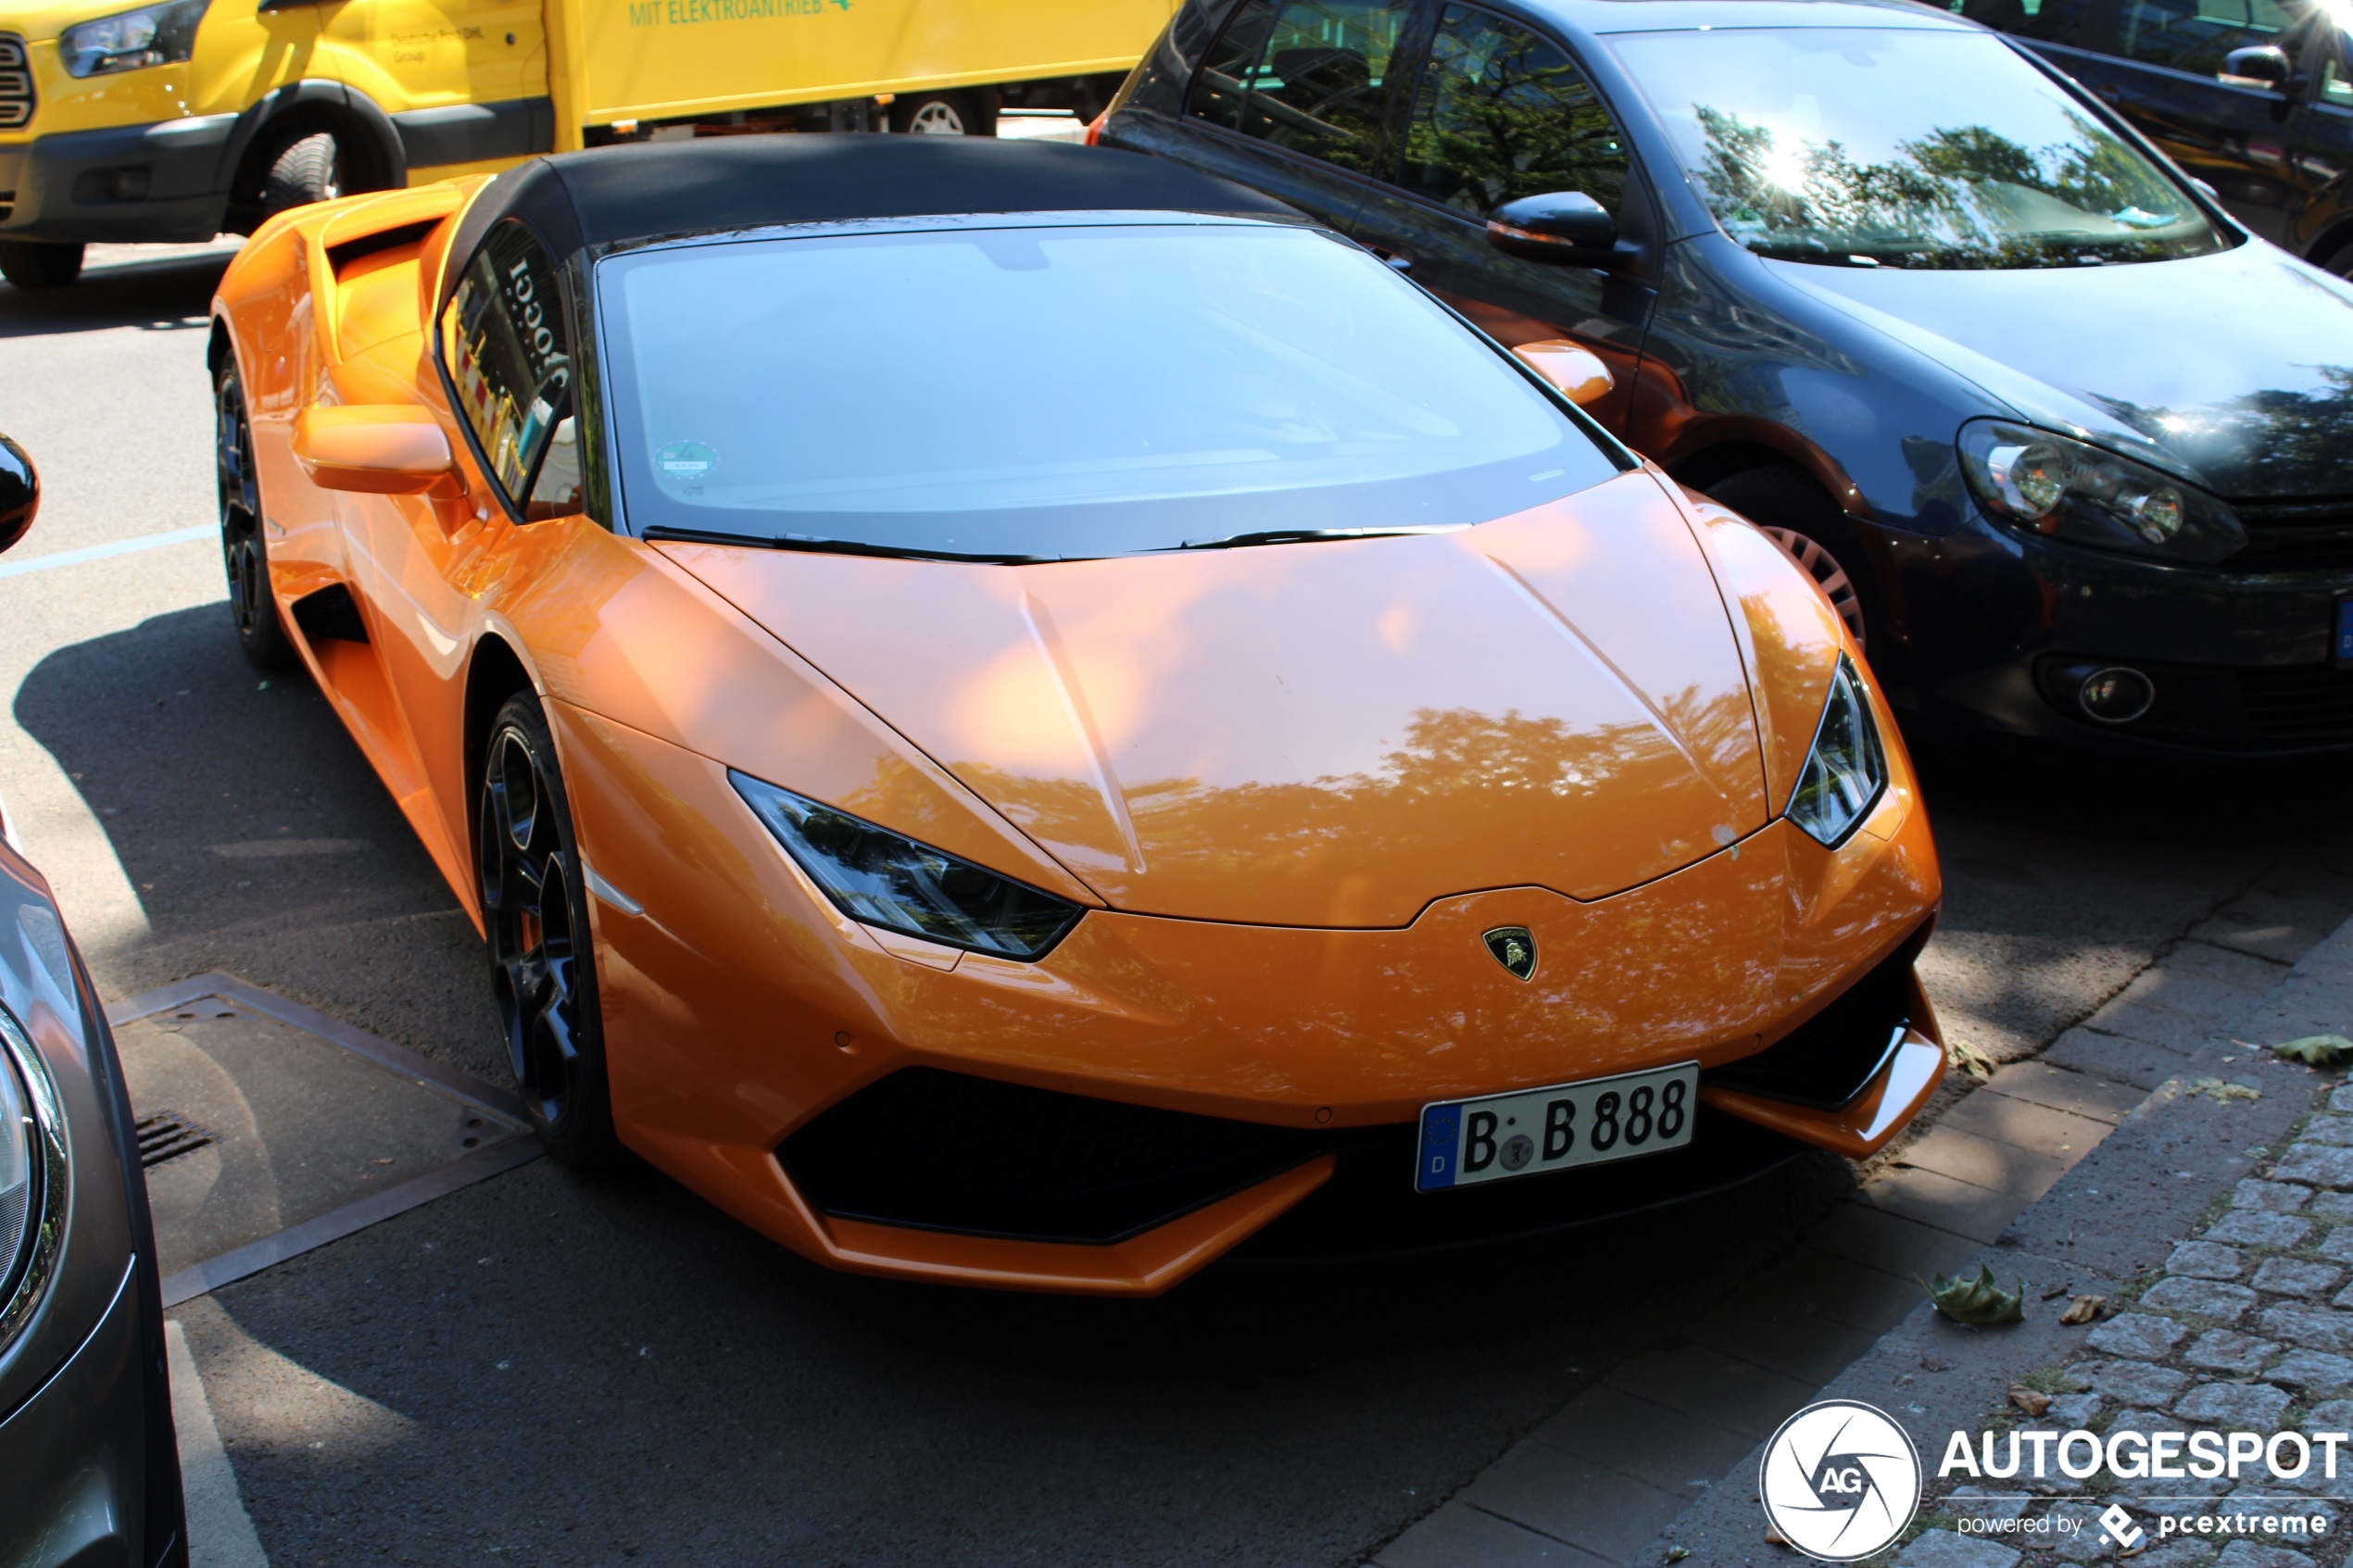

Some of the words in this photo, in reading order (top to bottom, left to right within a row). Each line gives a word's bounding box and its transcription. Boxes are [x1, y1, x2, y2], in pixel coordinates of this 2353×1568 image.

[629, 2, 661, 27] MIT
[391, 31, 437, 46] Deutsche
[439, 29, 462, 44] Post
[463, 27, 484, 40] DHL
[394, 49, 425, 64] Group
[678, 444, 695, 459] 4
[1464, 1110, 1498, 1173] B
[1432, 1157, 1445, 1173] D
